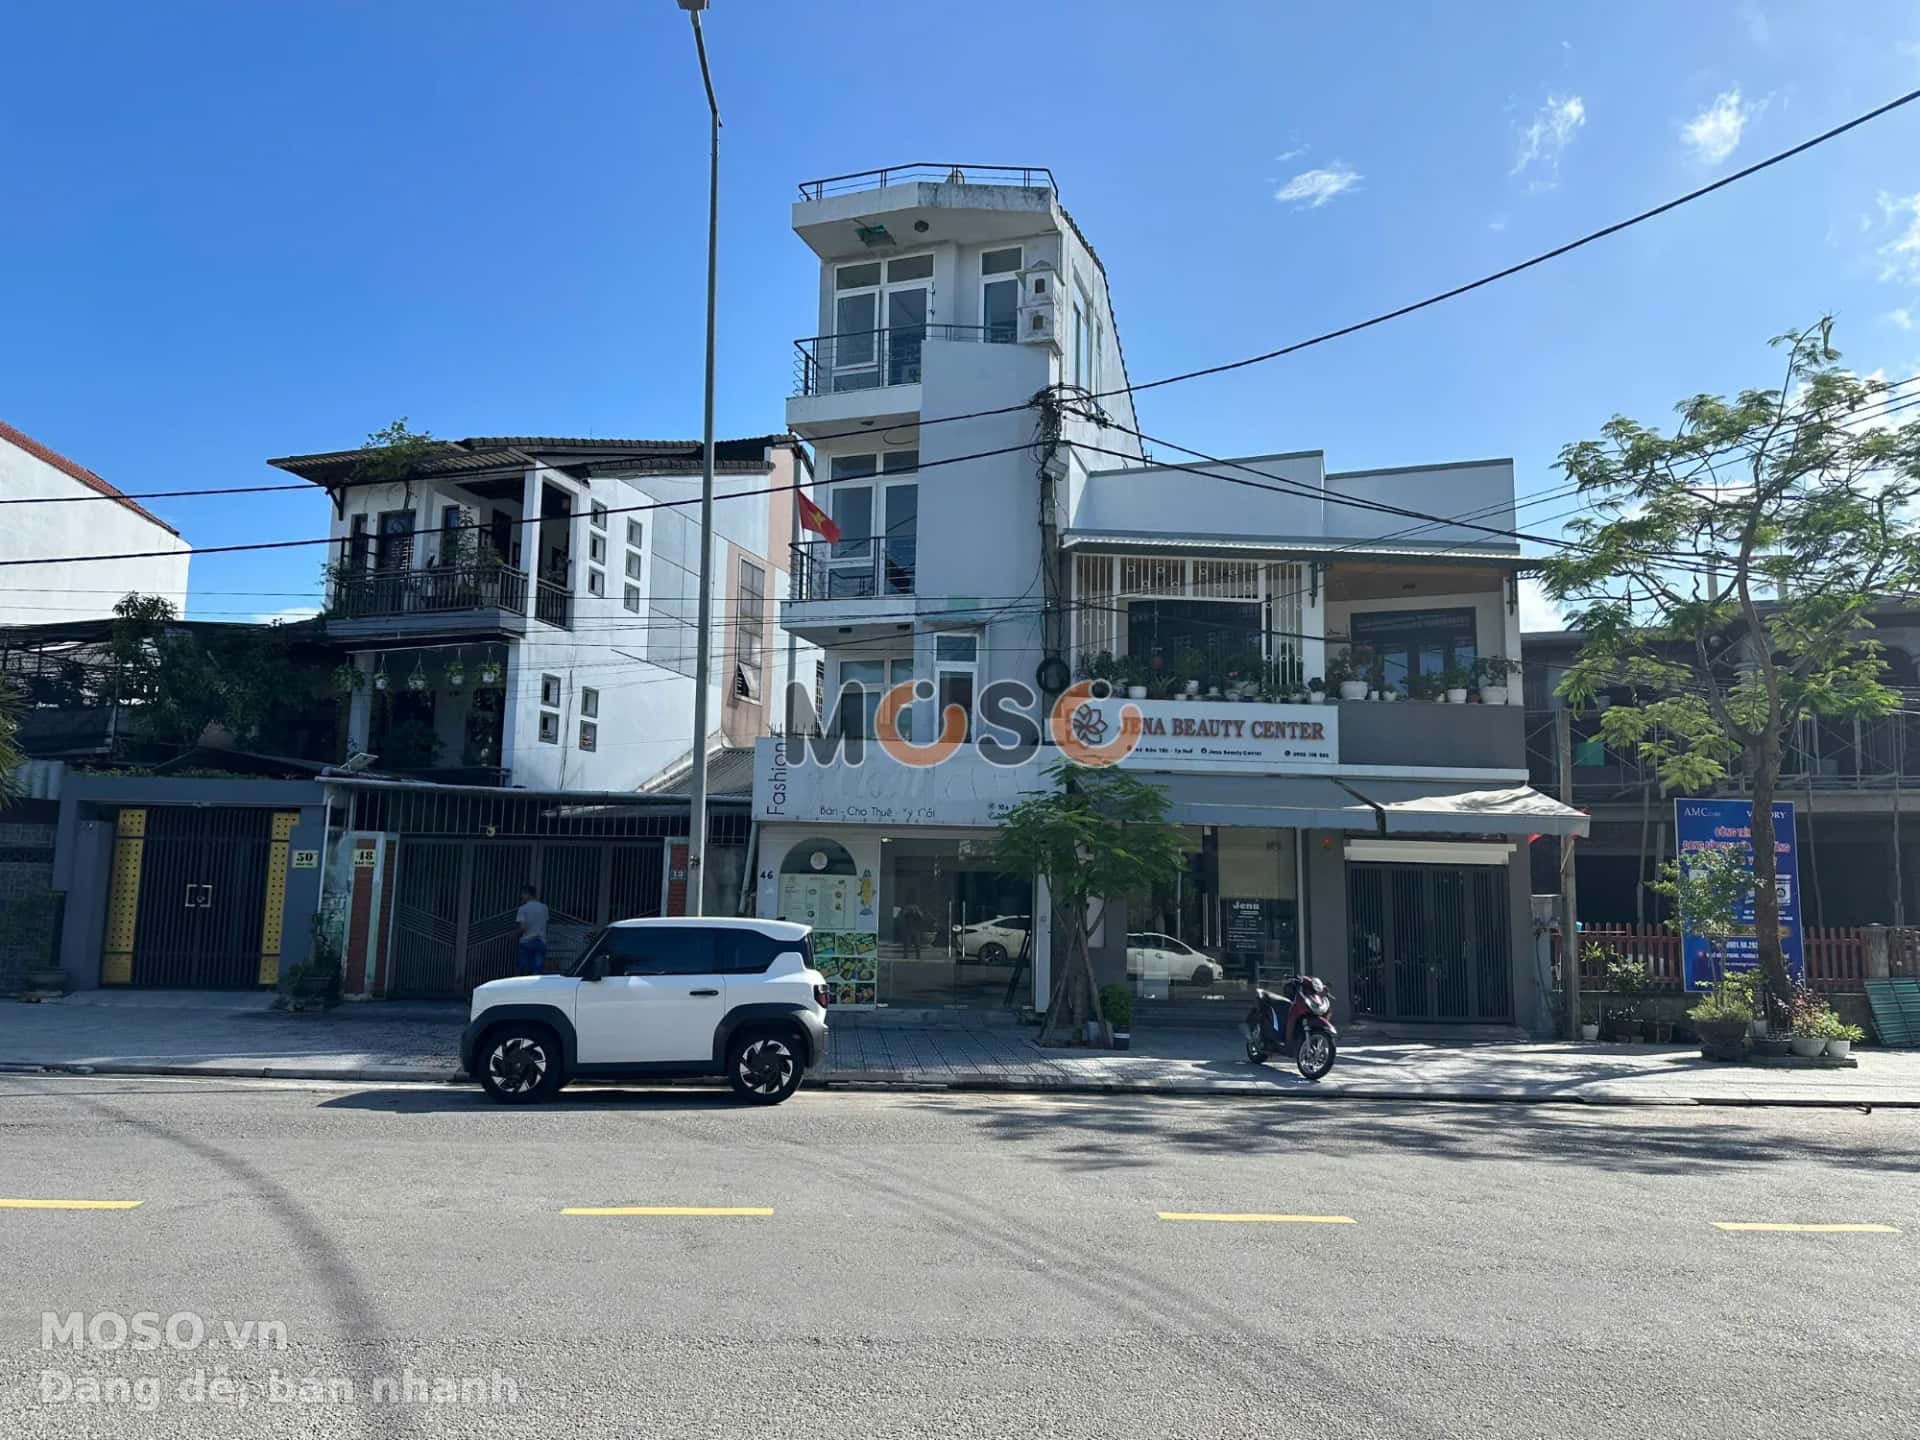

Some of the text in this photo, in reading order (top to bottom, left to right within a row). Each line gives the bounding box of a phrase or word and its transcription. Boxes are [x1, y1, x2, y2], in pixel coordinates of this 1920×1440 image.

[1118, 717, 1325, 739] JENA BEAUTY CENTER
[766, 741, 788, 815] Fashion
[847, 805, 868, 816] Cho
[1684, 807, 1708, 817] AMC
[296, 852, 313, 862] 50
[760, 870, 774, 880] 46
[1232, 901, 1260, 910] Jena
